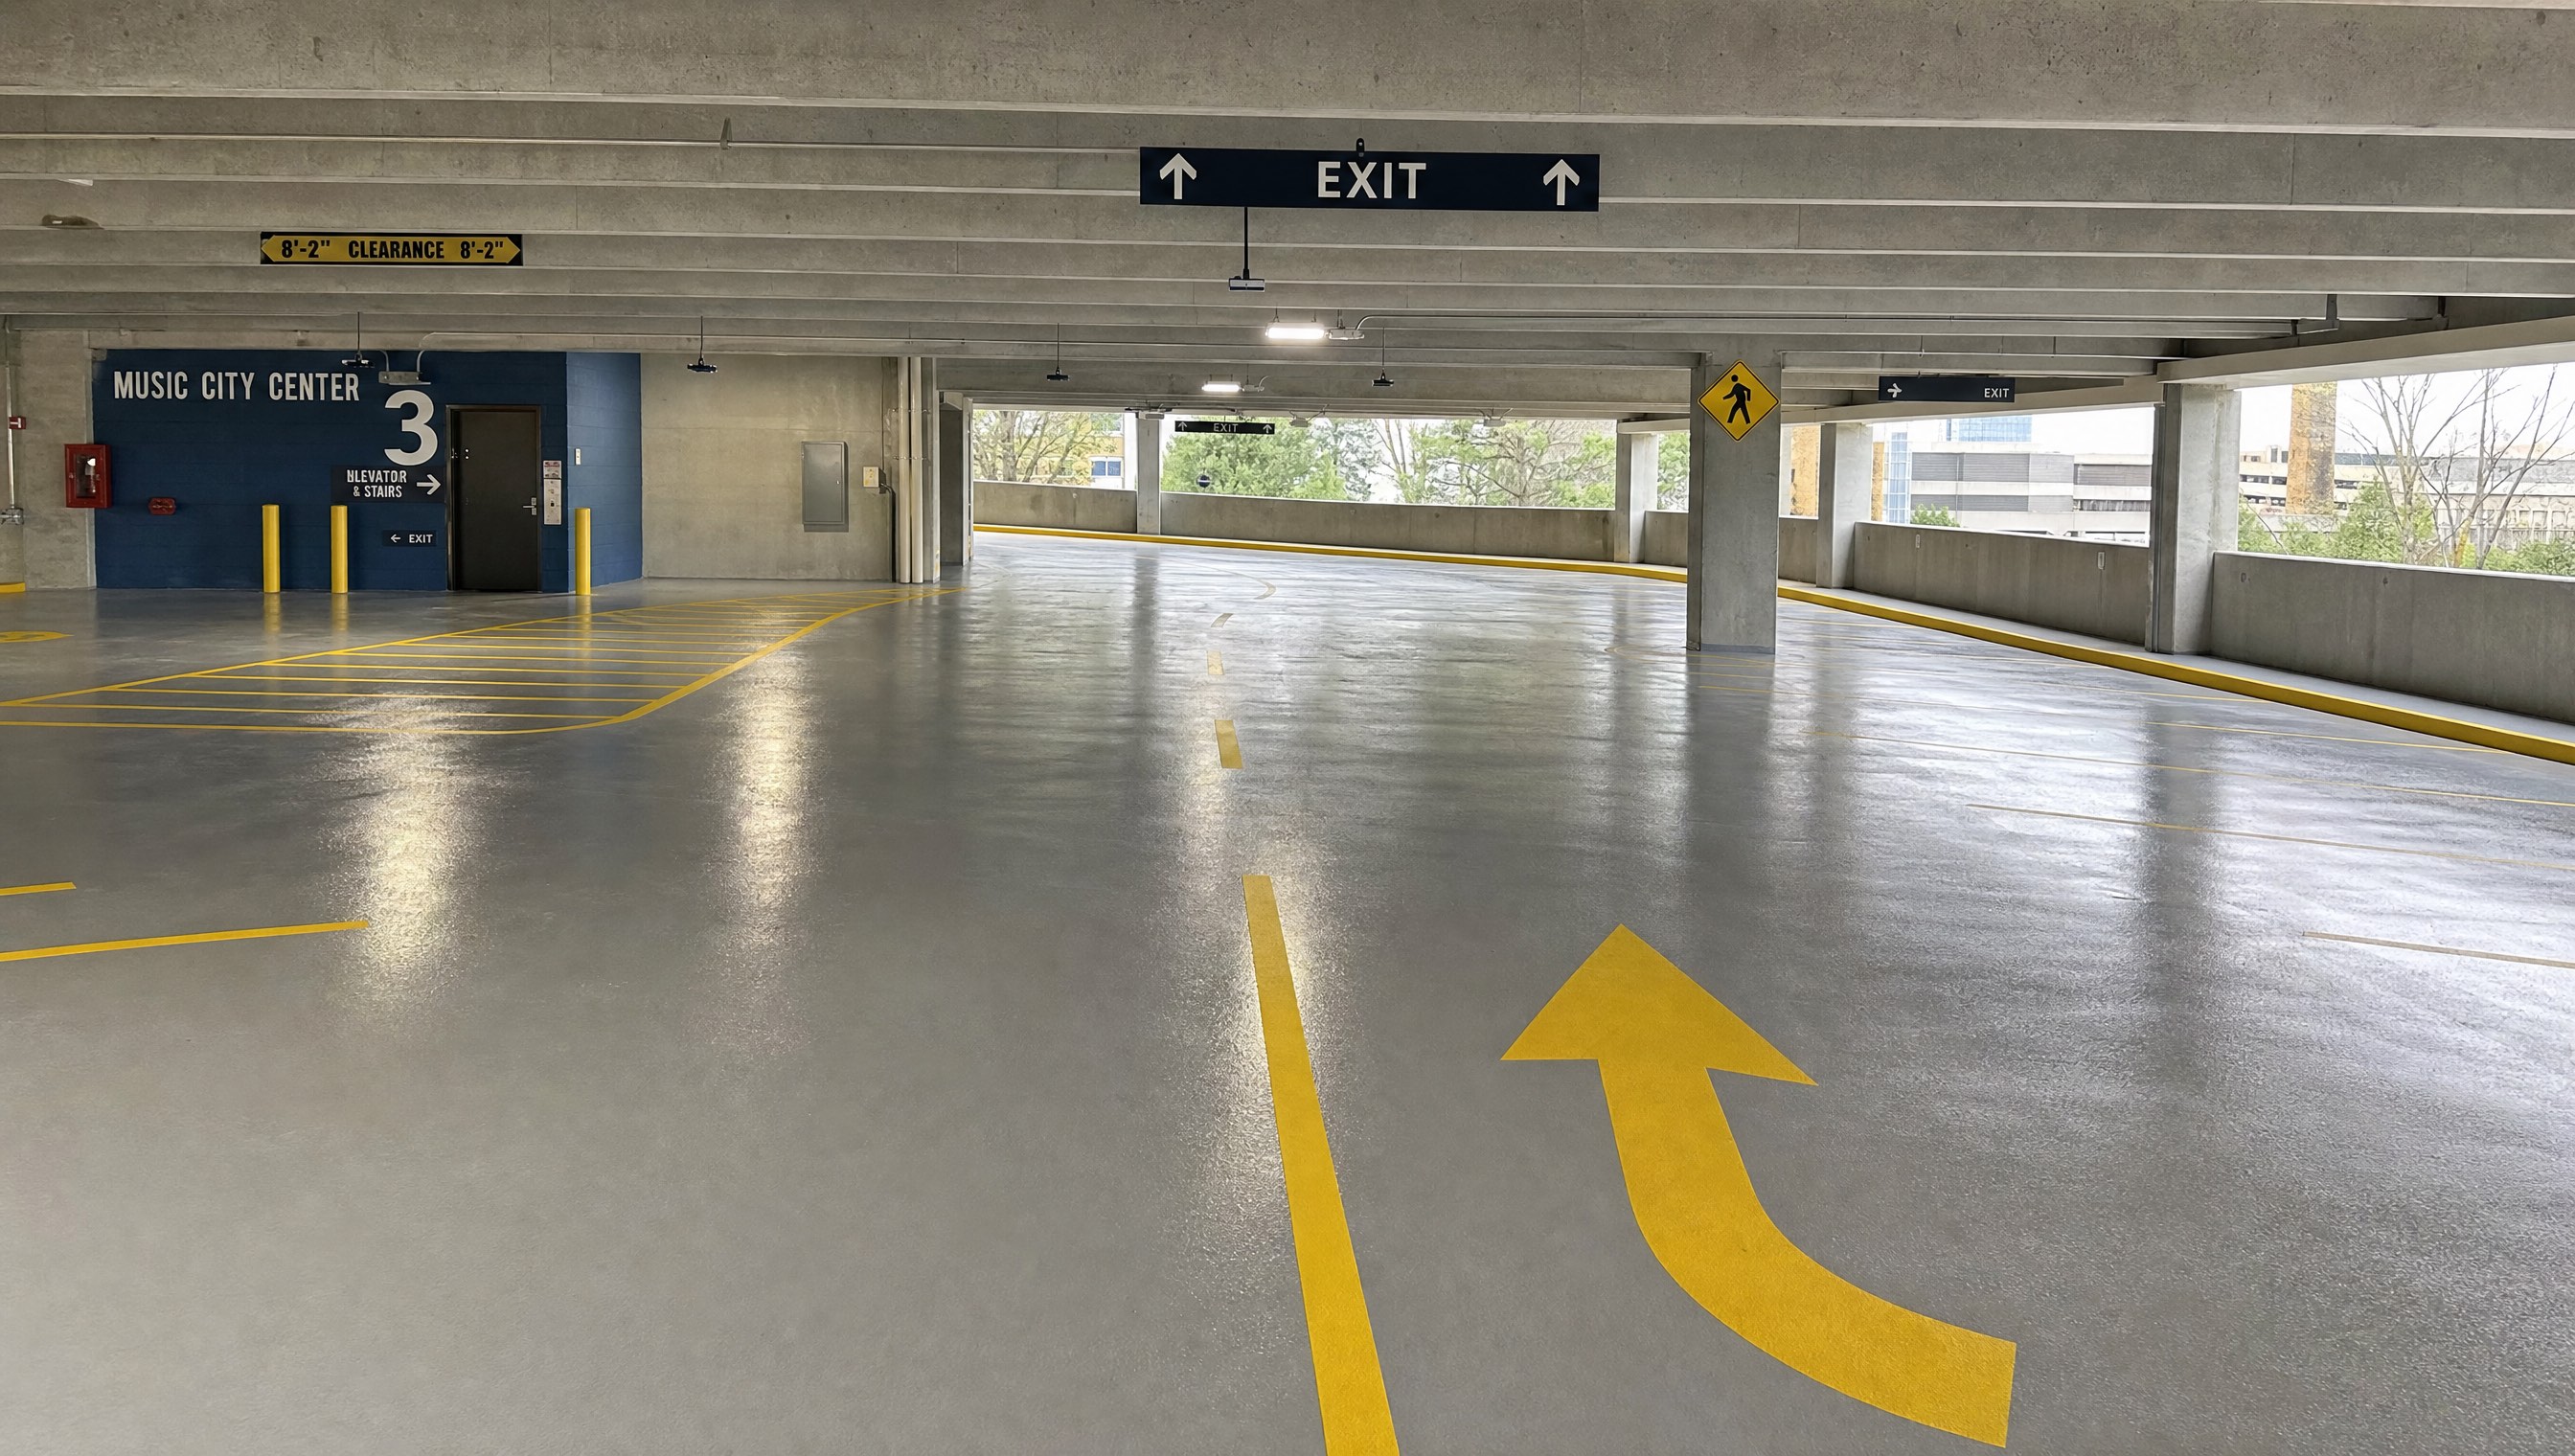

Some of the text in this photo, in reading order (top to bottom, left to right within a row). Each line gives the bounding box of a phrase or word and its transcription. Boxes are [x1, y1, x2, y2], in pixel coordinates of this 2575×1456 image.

[1317, 161, 1426, 199] EXIT
[281, 239, 504, 260] 8'-2" CLEARANCE 8'-2"
[114, 371, 359, 401] MUSIC CITY CENTER
[1984, 388, 2010, 398] EXIT
[384, 390, 438, 466] 3
[1213, 422, 1239, 432] EXIT
[353, 485, 402, 498] & STAIRS
[409, 534, 433, 543] EXIT
